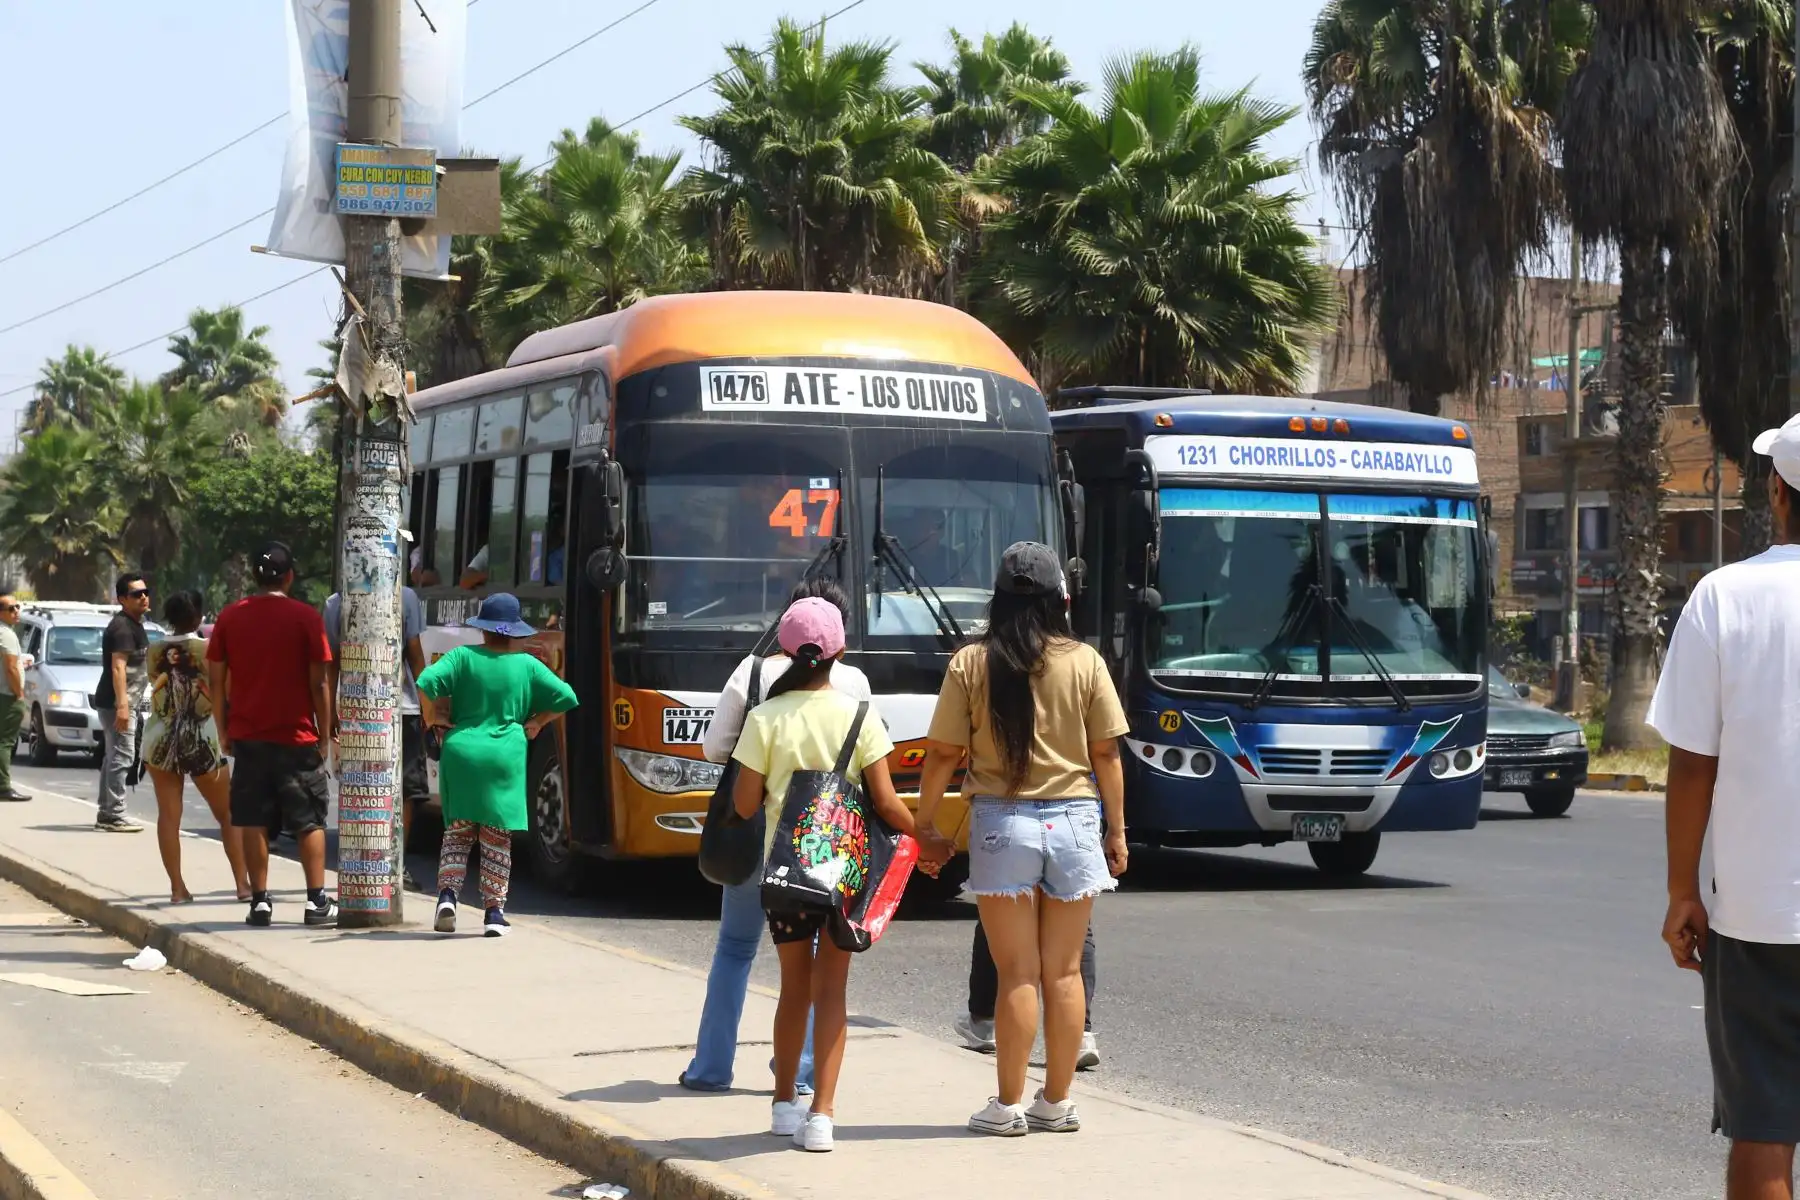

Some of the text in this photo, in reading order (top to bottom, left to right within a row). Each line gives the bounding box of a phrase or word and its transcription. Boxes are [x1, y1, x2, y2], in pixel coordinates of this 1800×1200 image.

[341, 167, 433, 185] CURA CON CUY NEGRO
[339, 199, 433, 211] 986 947 302
[713, 374, 766, 402] 1476
[784, 372, 841, 406] ATE
[860, 375, 900, 409] LOS
[905, 377, 978, 414] OLIVOS
[1177, 445, 1217, 465] 1231
[1229, 445, 1336, 468] CHORRILLOS
[1351, 449, 1453, 475] CARABAYLLO
[769, 488, 840, 537] 47
[354, 710, 384, 720] AMOR
[614, 703, 630, 725] 15
[1162, 713, 1178, 728] 78
[665, 719, 711, 742] 147
[342, 797, 385, 808] DE AMOR
[341, 885, 383, 897] DE AMOR
